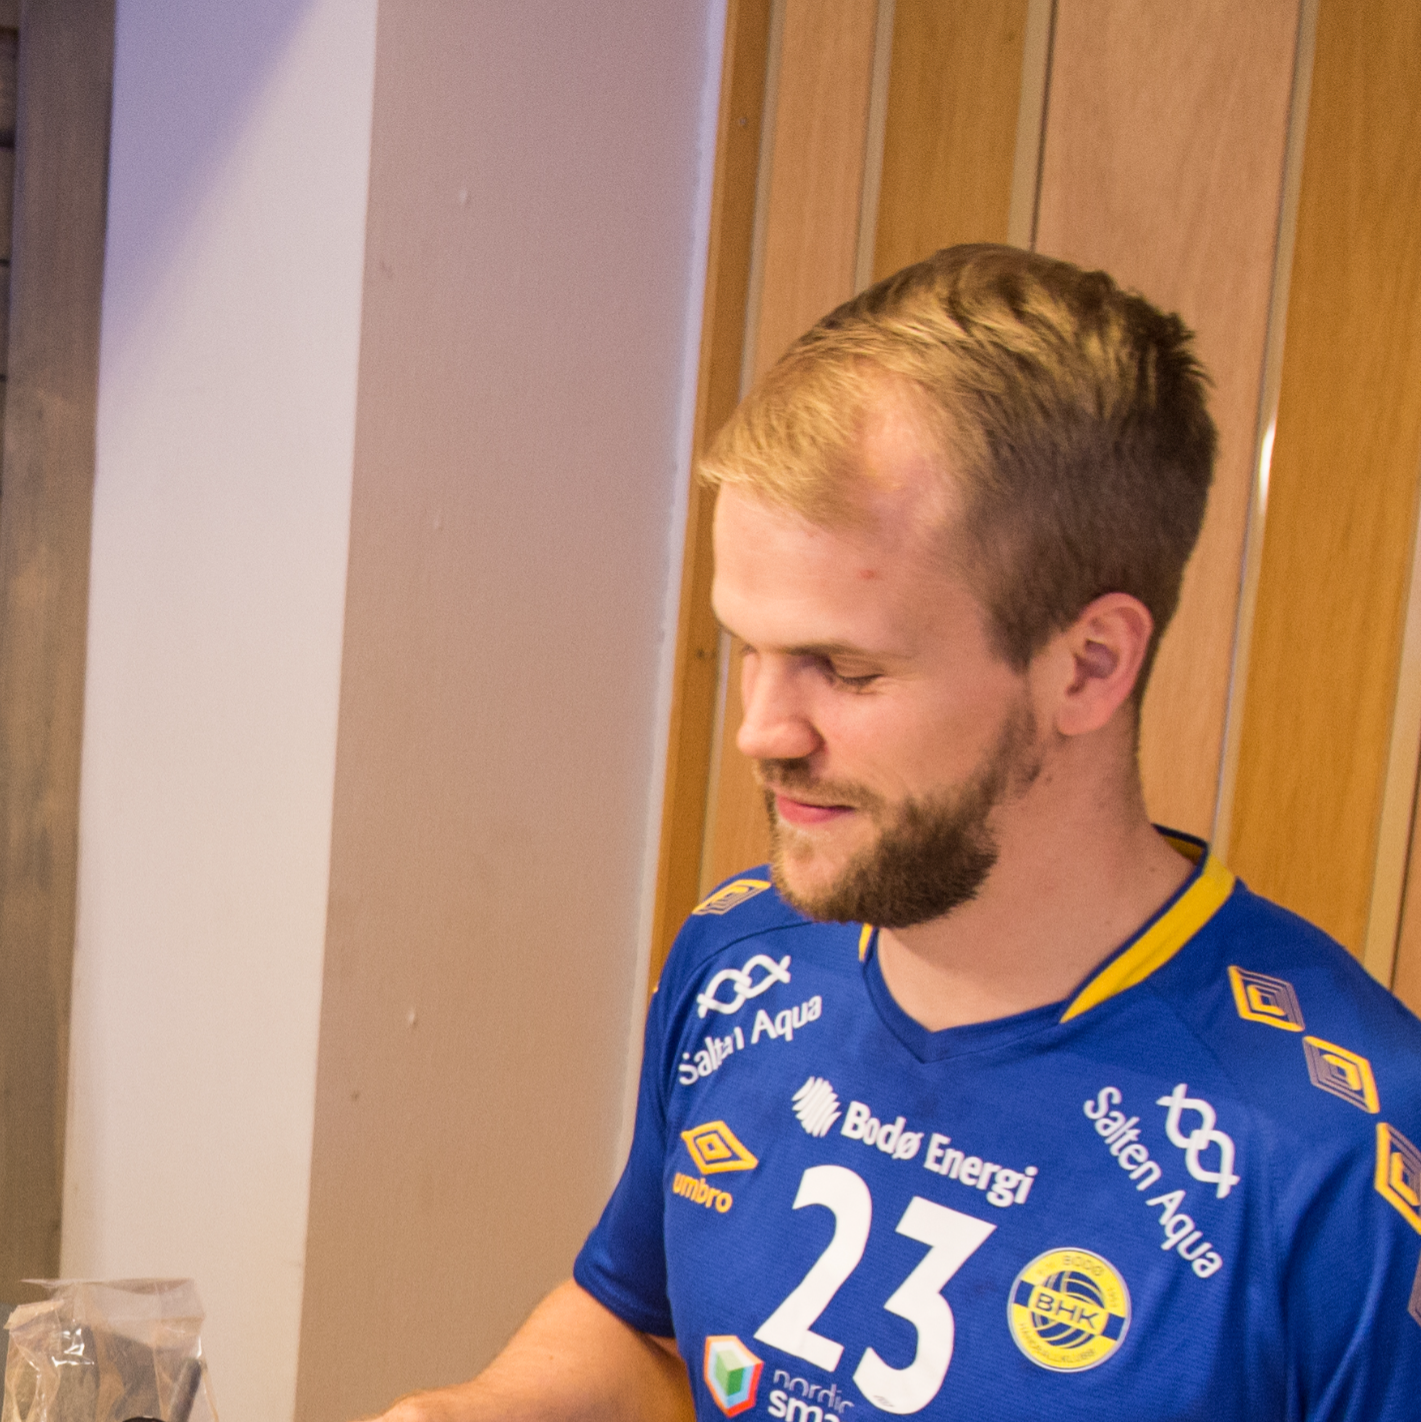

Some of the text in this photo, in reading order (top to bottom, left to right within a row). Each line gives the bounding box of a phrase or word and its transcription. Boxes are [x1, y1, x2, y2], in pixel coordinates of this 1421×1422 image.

[751, 995, 822, 1044] Aqua
[840, 1100, 1038, 1208] Bodø Energi
[673, 1172, 733, 1213] umbro
[1083, 1085, 1224, 1279] Salten Aqua
[753, 1165, 997, 1415] 23
[1035, 1292, 1100, 1330] BHK
[773, 1369, 855, 1413] nordic
